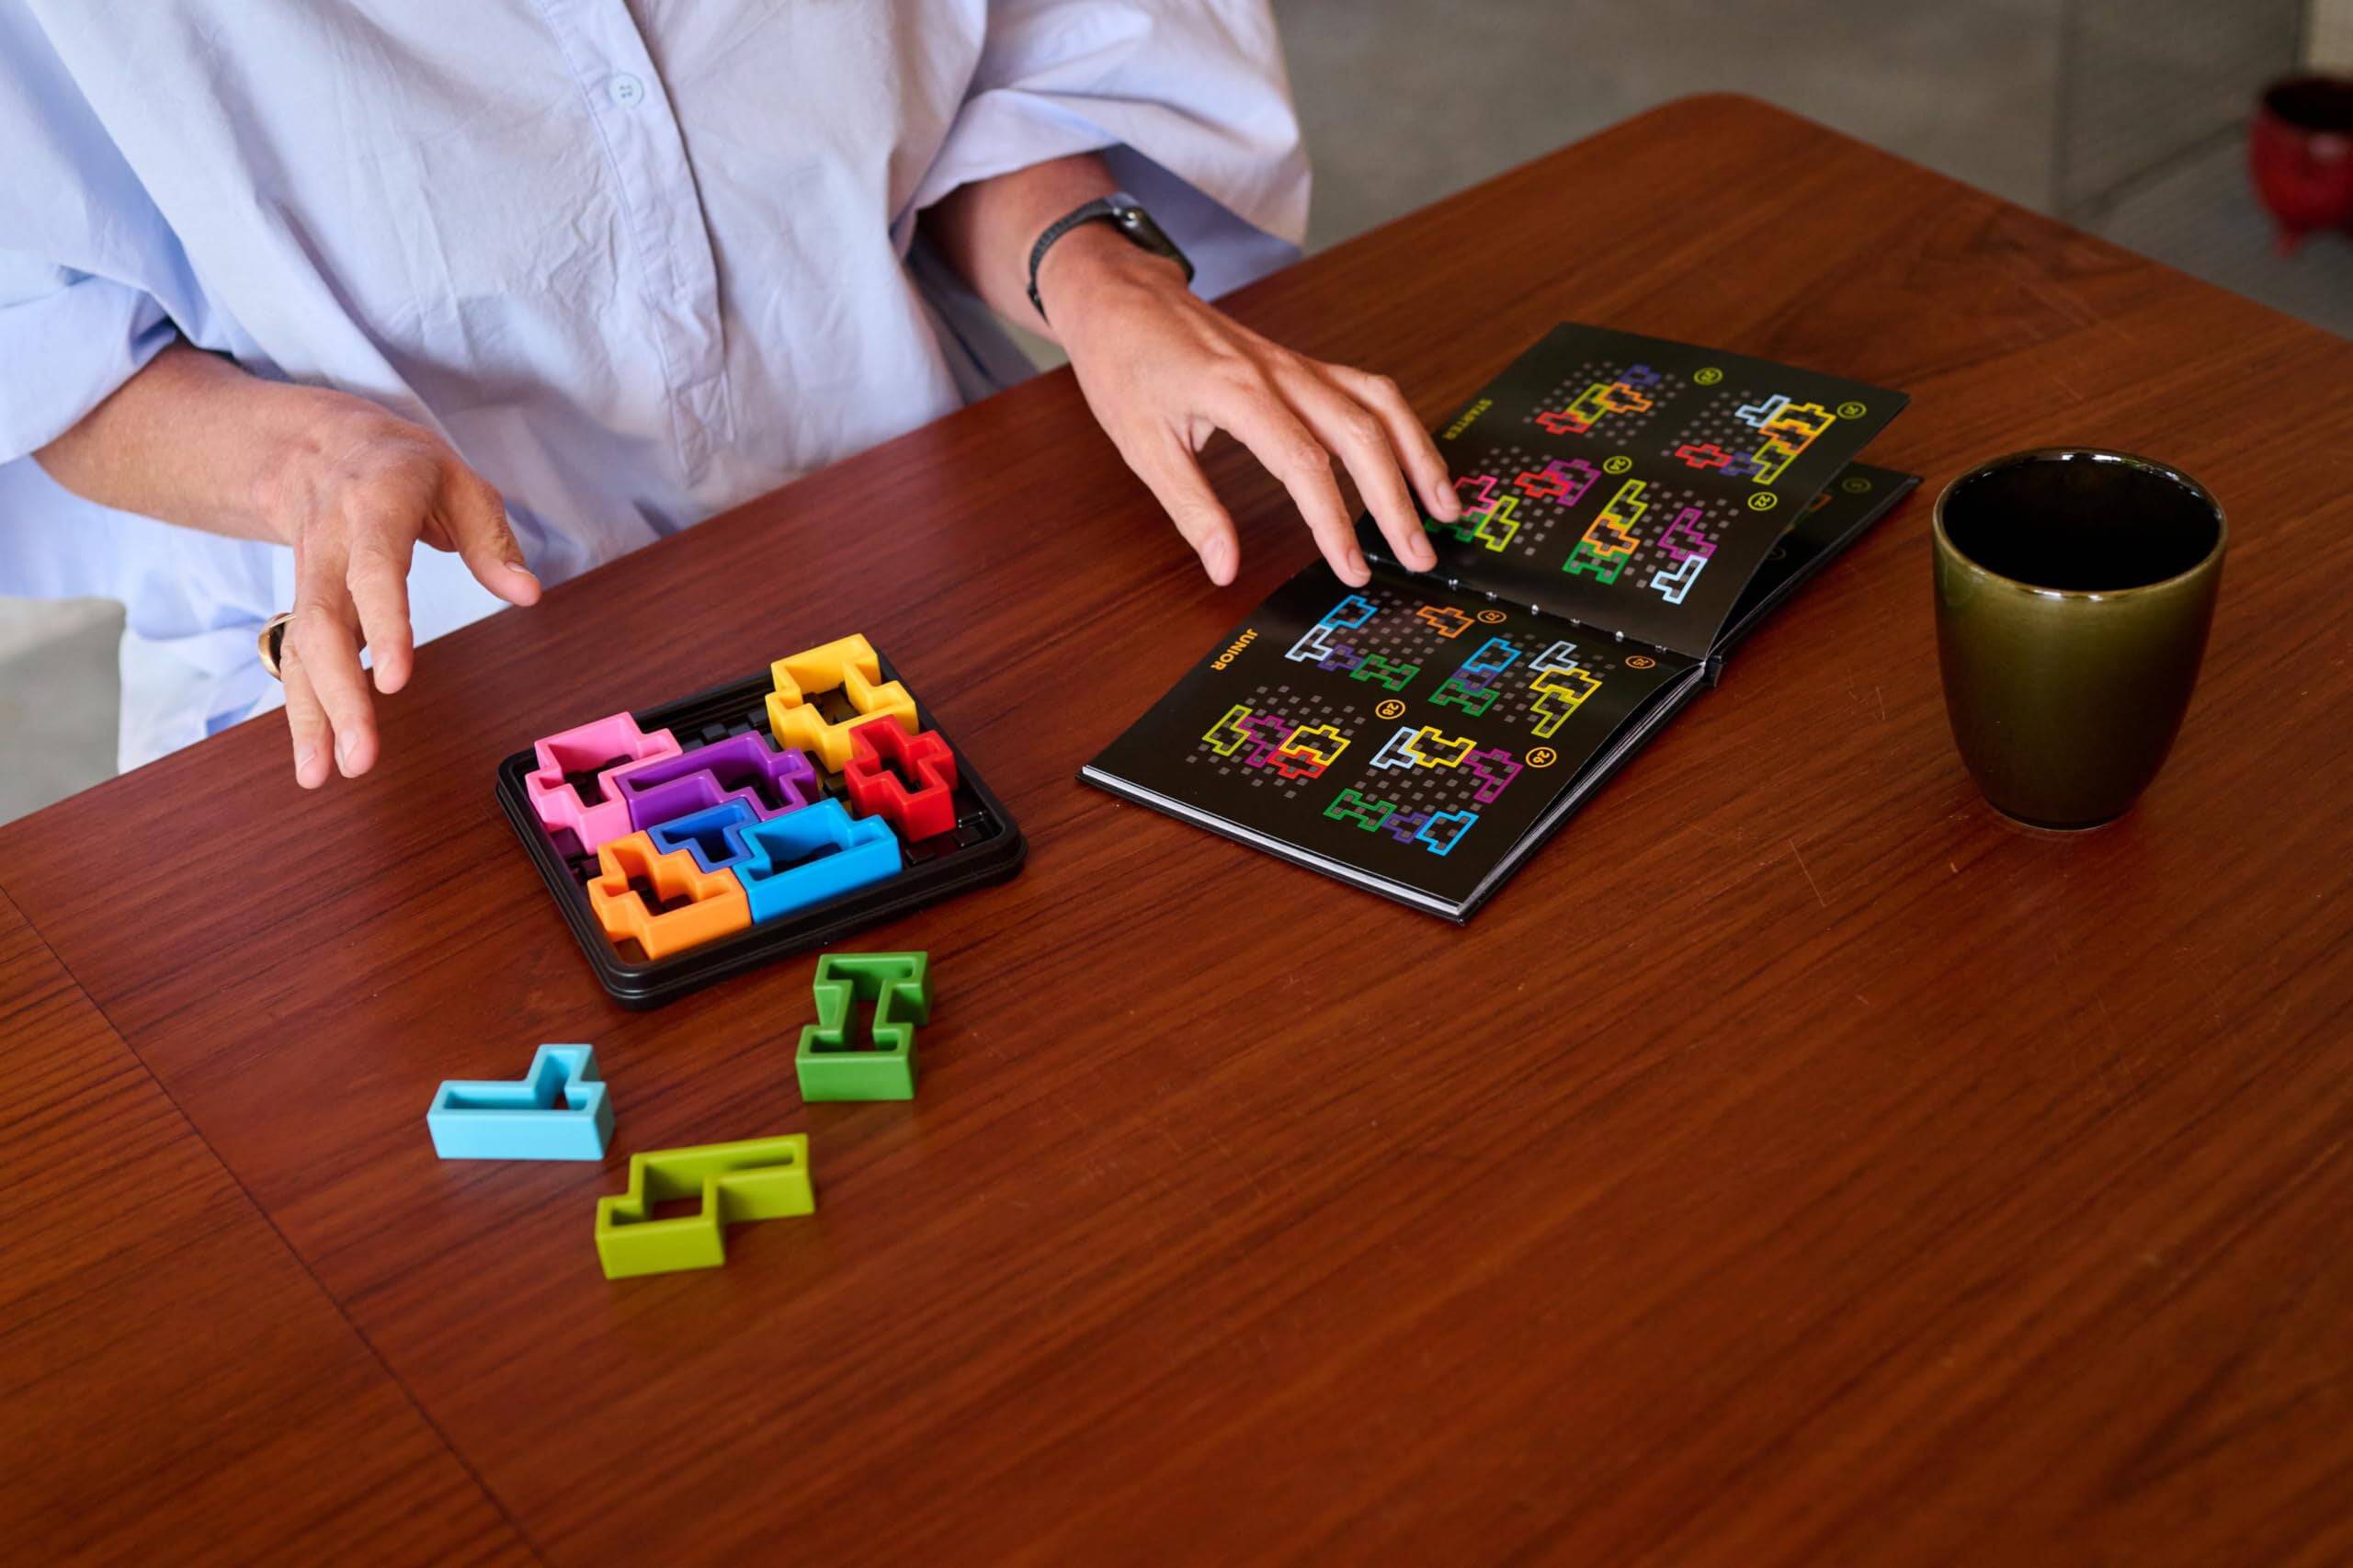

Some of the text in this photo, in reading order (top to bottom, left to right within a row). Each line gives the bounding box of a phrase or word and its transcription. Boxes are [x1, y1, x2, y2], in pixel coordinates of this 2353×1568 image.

[1211, 629, 1258, 670] JUNIOR
[1382, 702, 1400, 716] 28
[1533, 750, 1551, 764] 26
